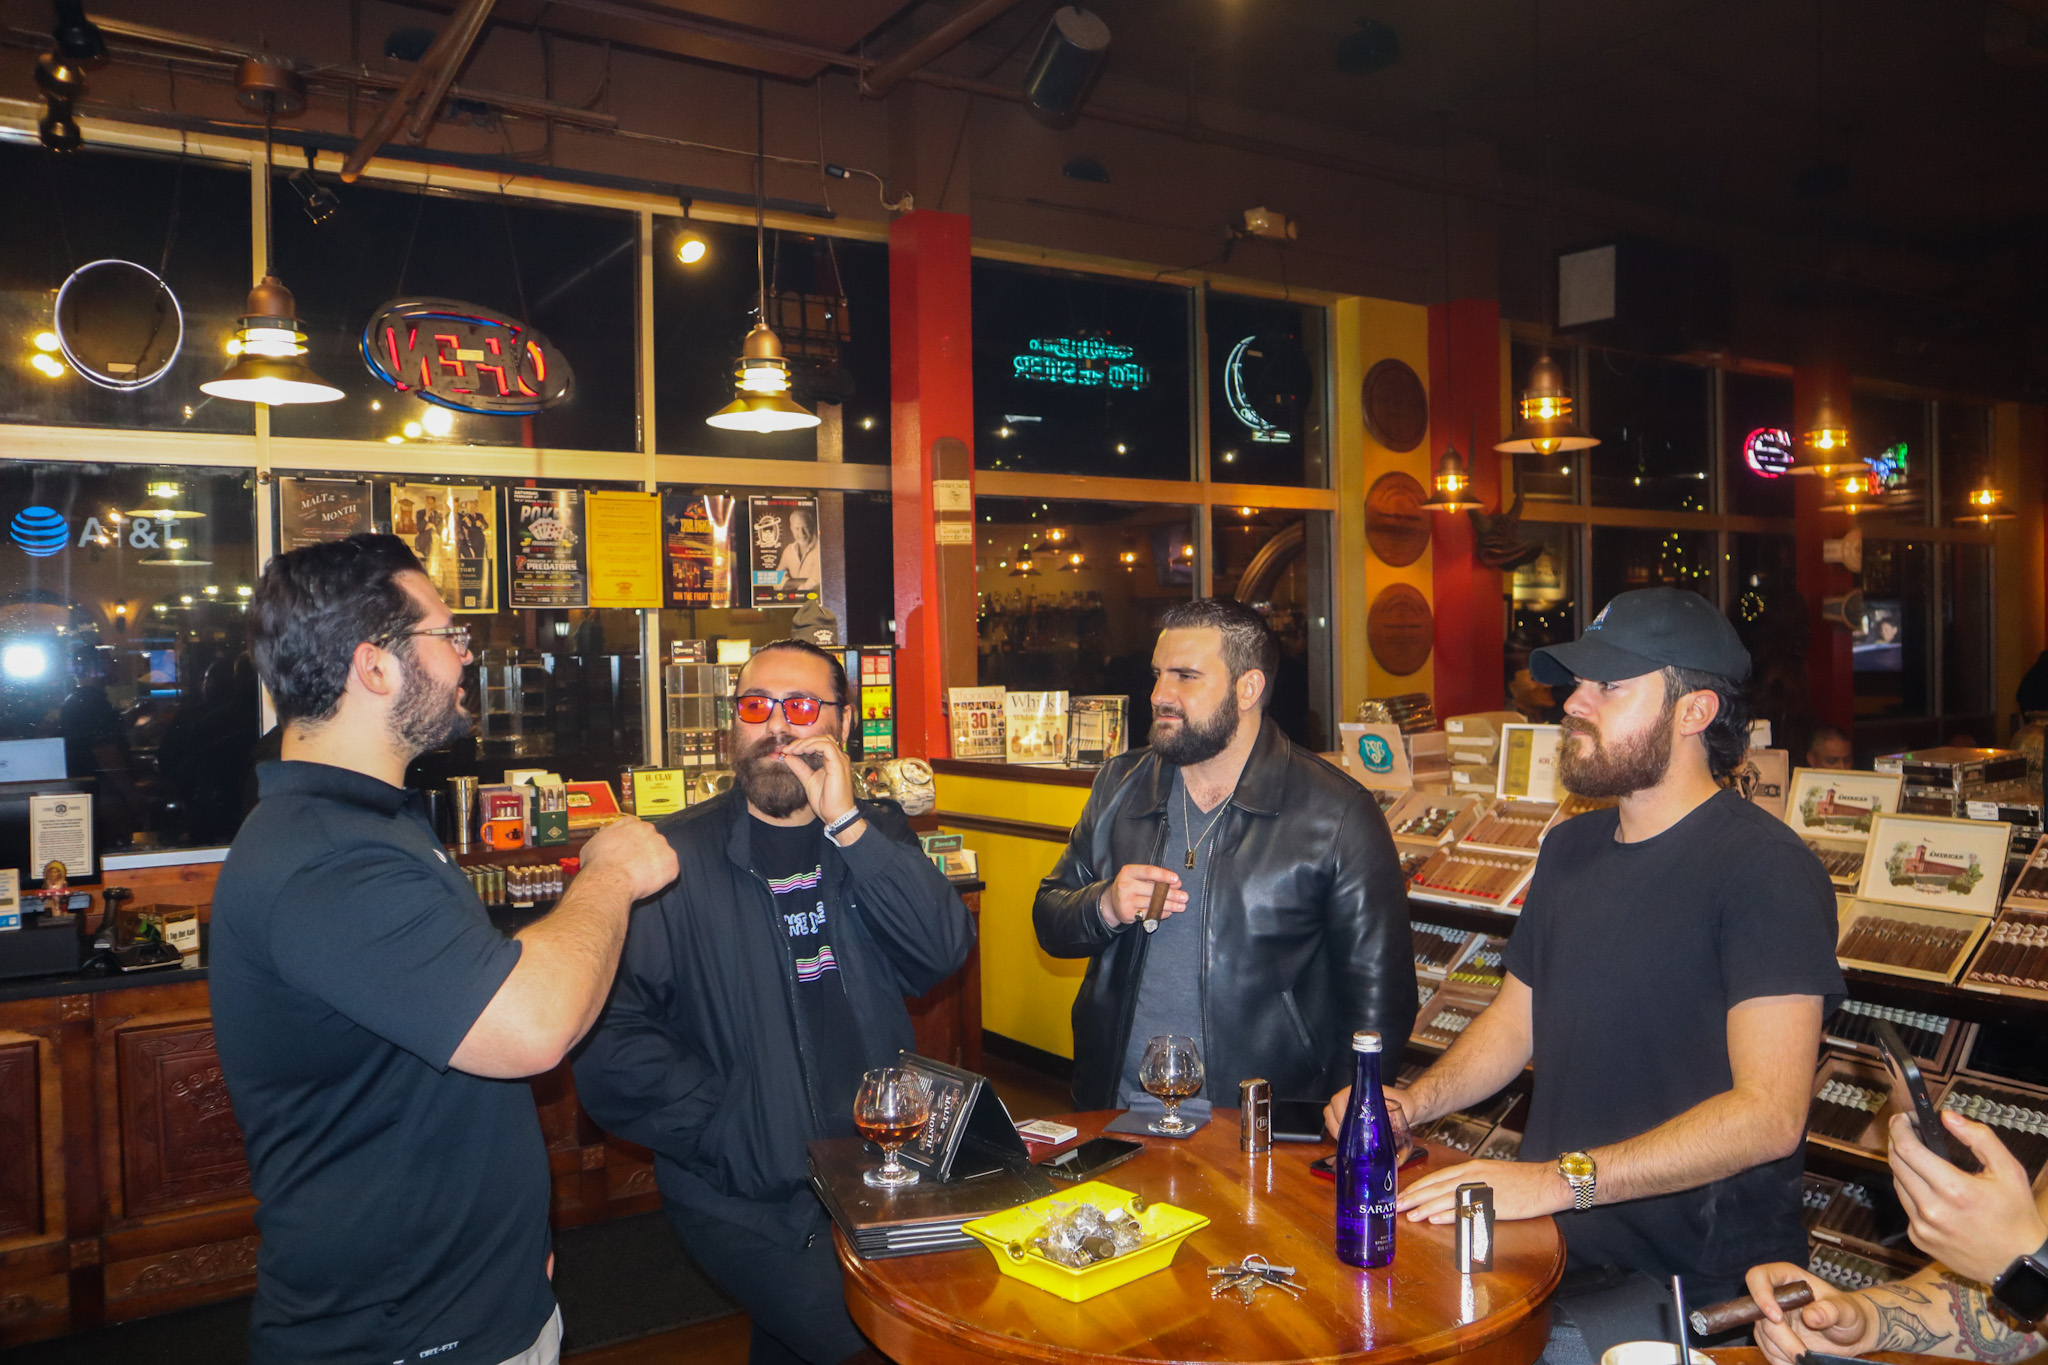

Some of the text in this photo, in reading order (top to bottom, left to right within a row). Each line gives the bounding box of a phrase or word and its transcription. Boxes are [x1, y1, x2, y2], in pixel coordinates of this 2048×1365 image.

[301, 493, 328, 510] MALT
[321, 504, 357, 522] MONTH
[520, 505, 572, 522] POKER
[78, 517, 180, 549] AT&T
[526, 563, 577, 571] PREDATORS
[683, 591, 693, 601] THE
[693, 592, 709, 601] FIGHT
[1012, 690, 1064, 708] Whiky
[971, 712, 988, 729] 30
[654, 773, 672, 781] CLAY
[1838, 794, 1868, 802] AMERICAN
[1929, 852, 1964, 860] AMERICAN
[943, 1095, 952, 1123] MALT
[926, 1111, 938, 1148] MONTH
[419, 1341, 459, 1359] DRI-FIT
